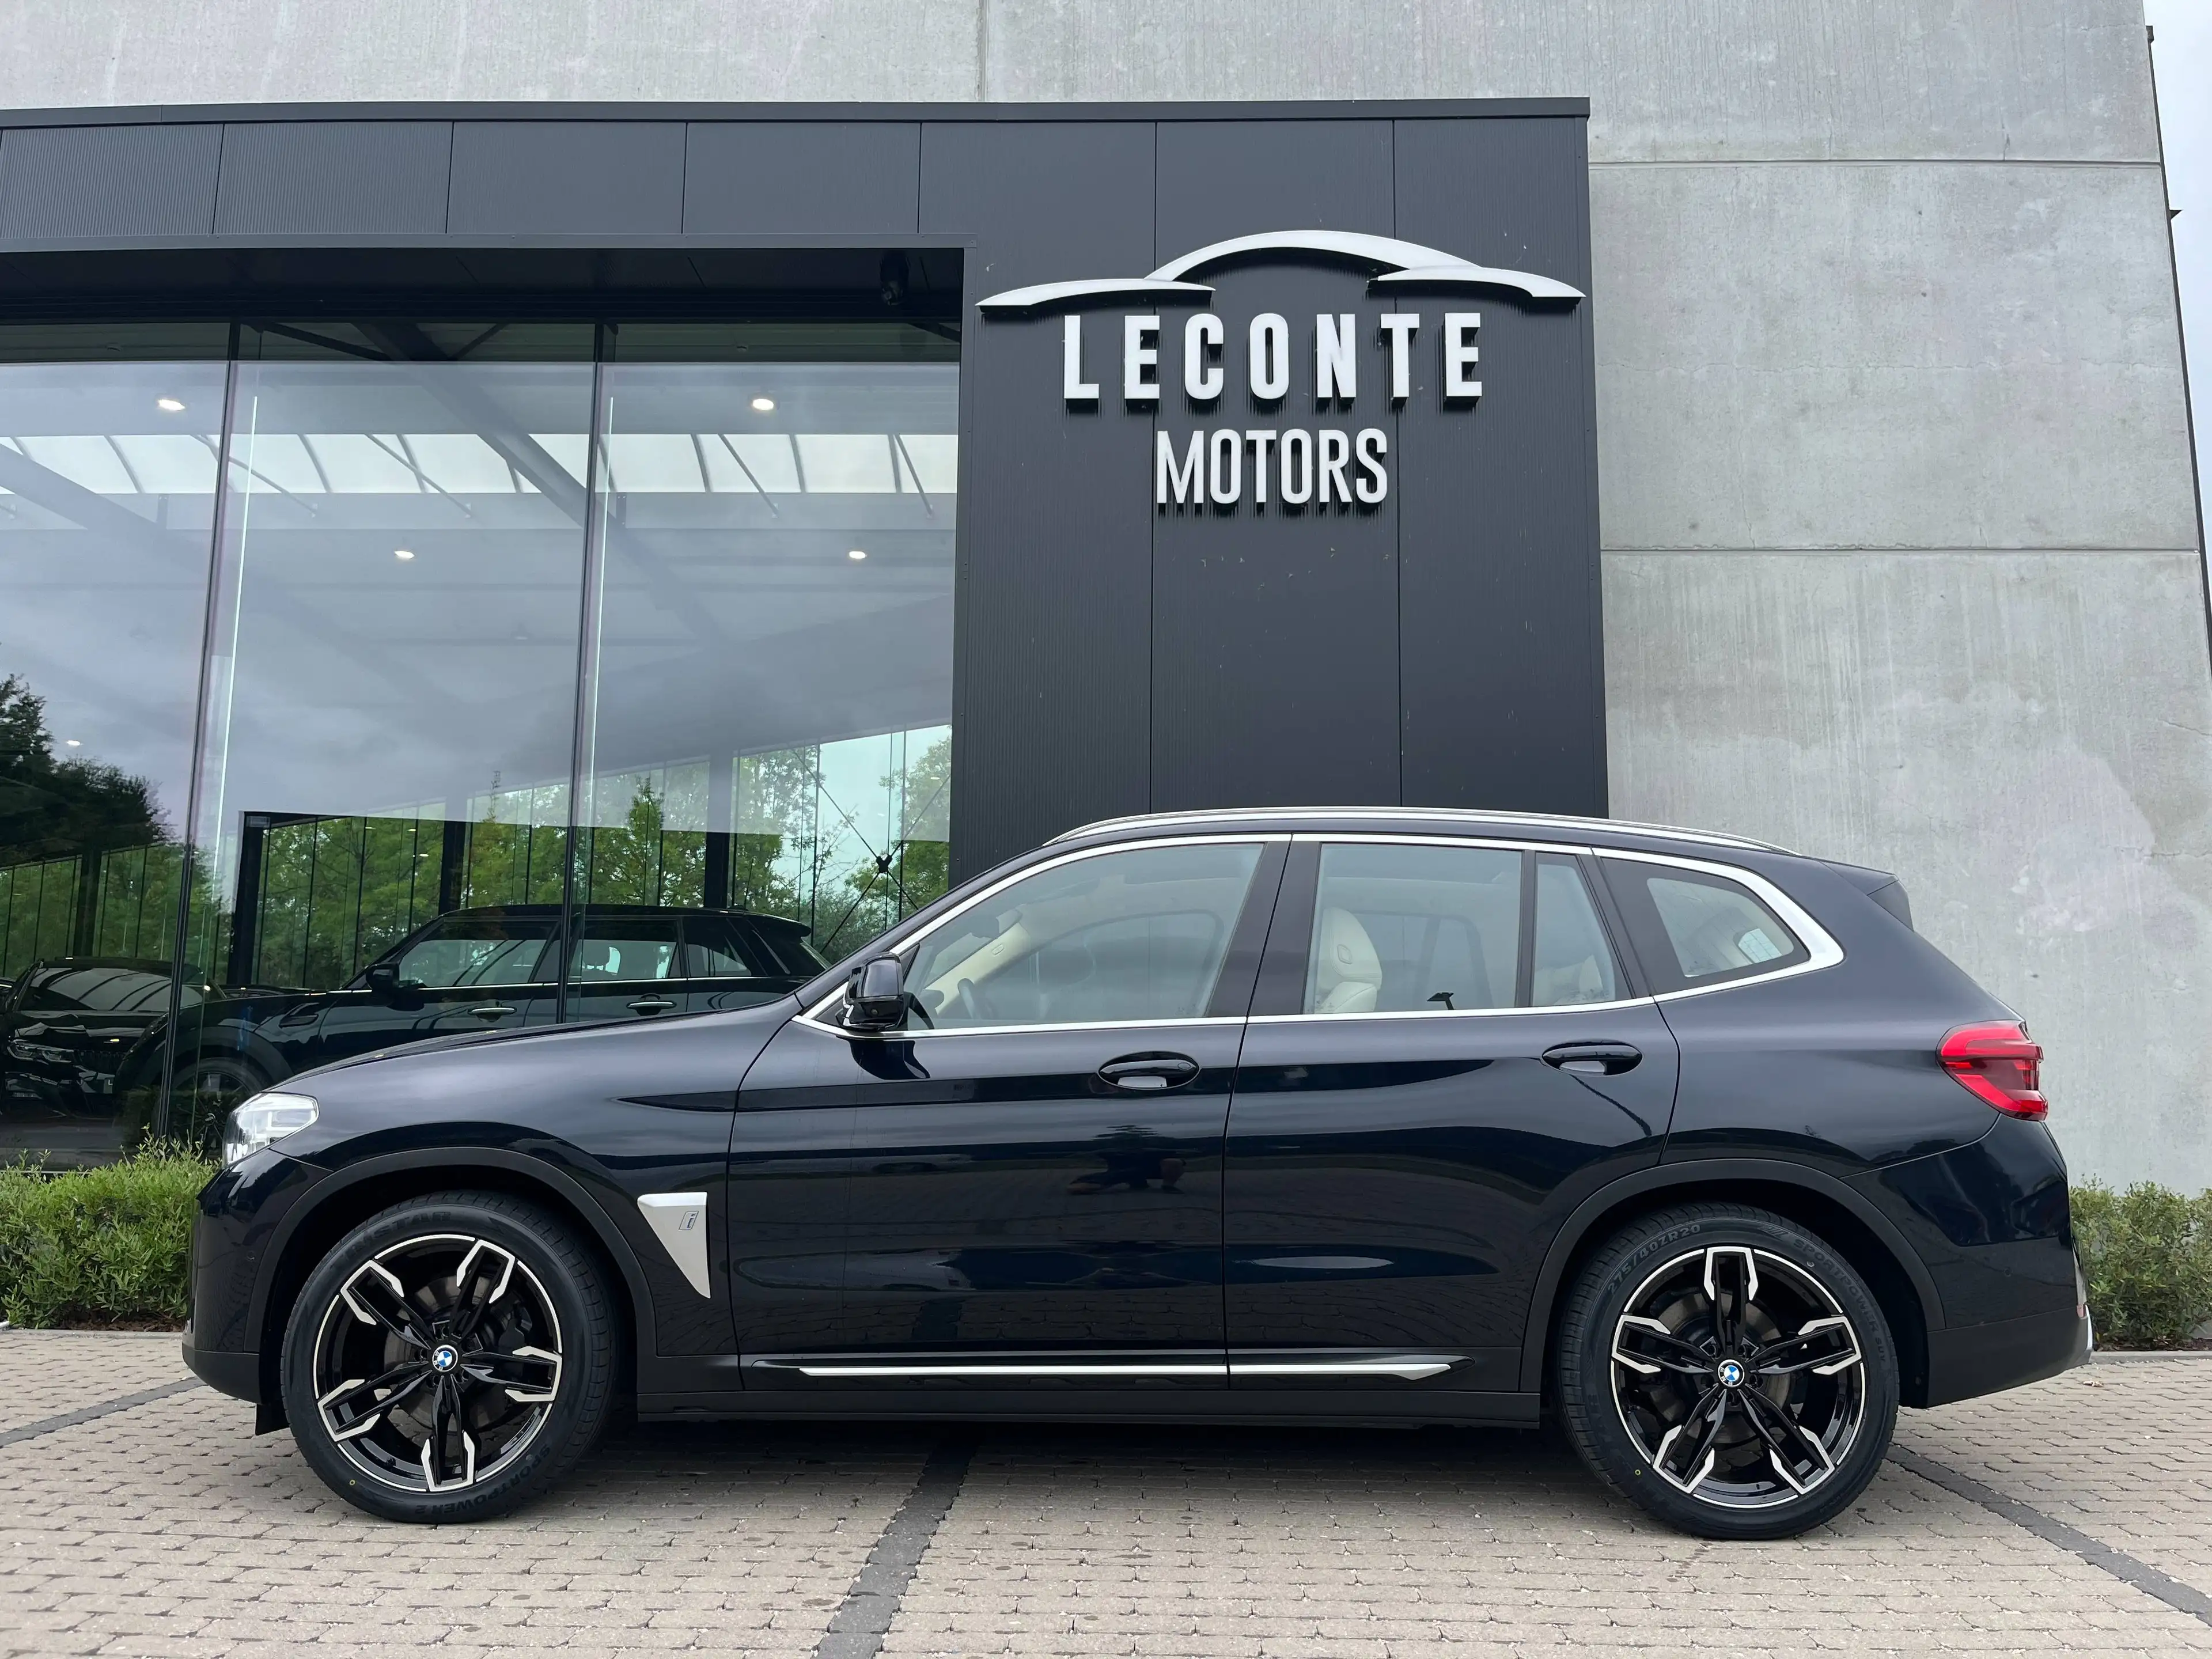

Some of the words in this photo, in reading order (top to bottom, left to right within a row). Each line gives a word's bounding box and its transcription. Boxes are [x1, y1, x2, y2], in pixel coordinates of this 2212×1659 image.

[1063, 312, 1483, 400] LECONTE
[1156, 428, 1388, 504] MOTORS
[1607, 1224, 1701, 1294] 275/40ZR20
